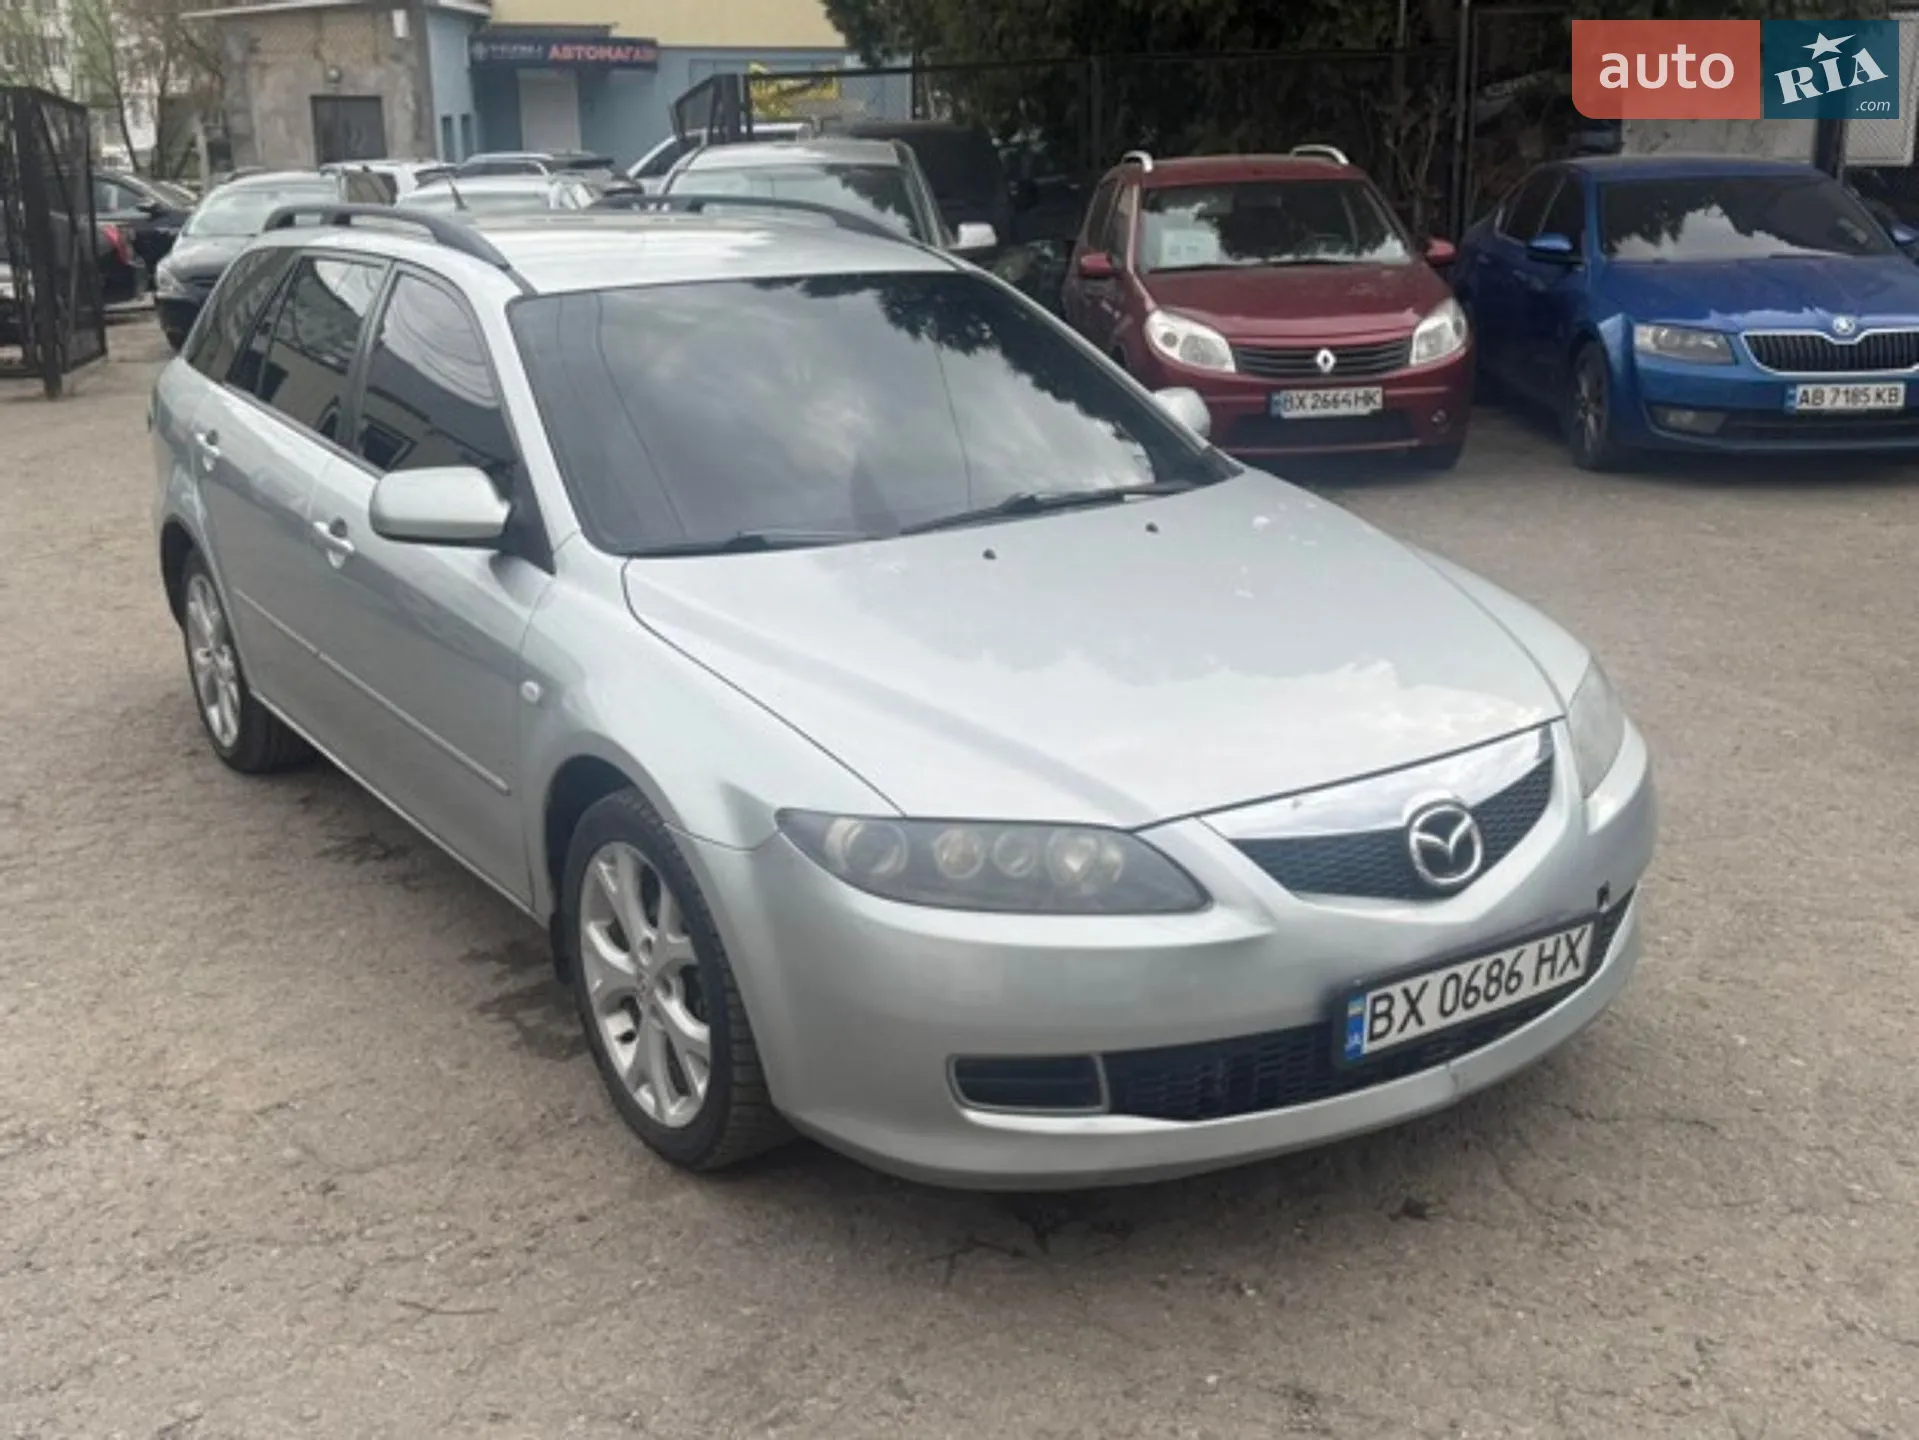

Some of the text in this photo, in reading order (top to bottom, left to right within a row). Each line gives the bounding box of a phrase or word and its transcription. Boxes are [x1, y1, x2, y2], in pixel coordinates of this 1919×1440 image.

[1366, 926, 1589, 1042] BX 0686 HX
